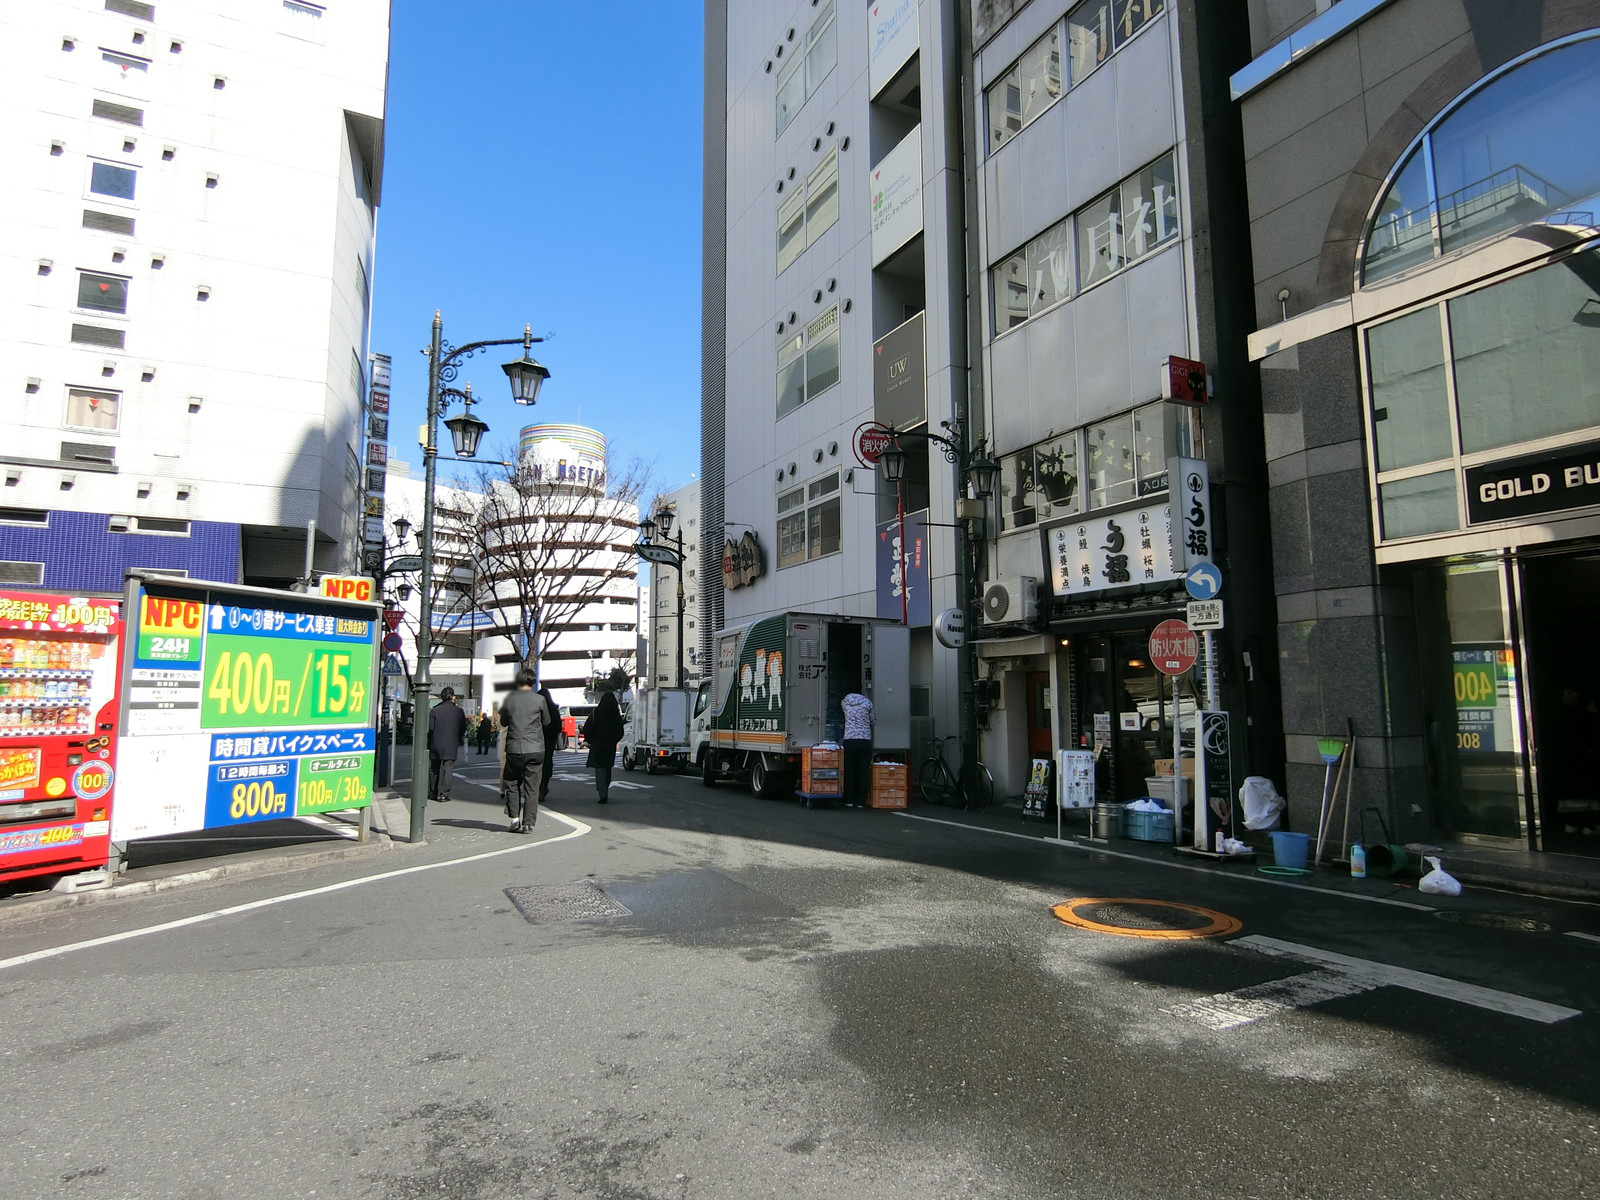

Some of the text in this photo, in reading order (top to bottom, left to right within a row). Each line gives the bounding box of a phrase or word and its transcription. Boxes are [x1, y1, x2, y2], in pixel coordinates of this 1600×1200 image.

[889, 358, 907, 378] UW
[1480, 473, 1551, 503] GOLD
[1184, 495, 1208, 556] う福
[1100, 519, 1130, 583] う福
[1058, 543, 1071, 590] 栄養満点
[326, 579, 370, 601] NPC
[56, 603, 112, 627] 100円
[145, 596, 200, 630] NPC
[1190, 611, 1220, 620] 一方通行
[151, 636, 190, 654] 24H
[215, 733, 366, 758] 時間貸バイクスペース
[312, 760, 358, 770] オールタイム
[230, 780, 287, 819] 800円
